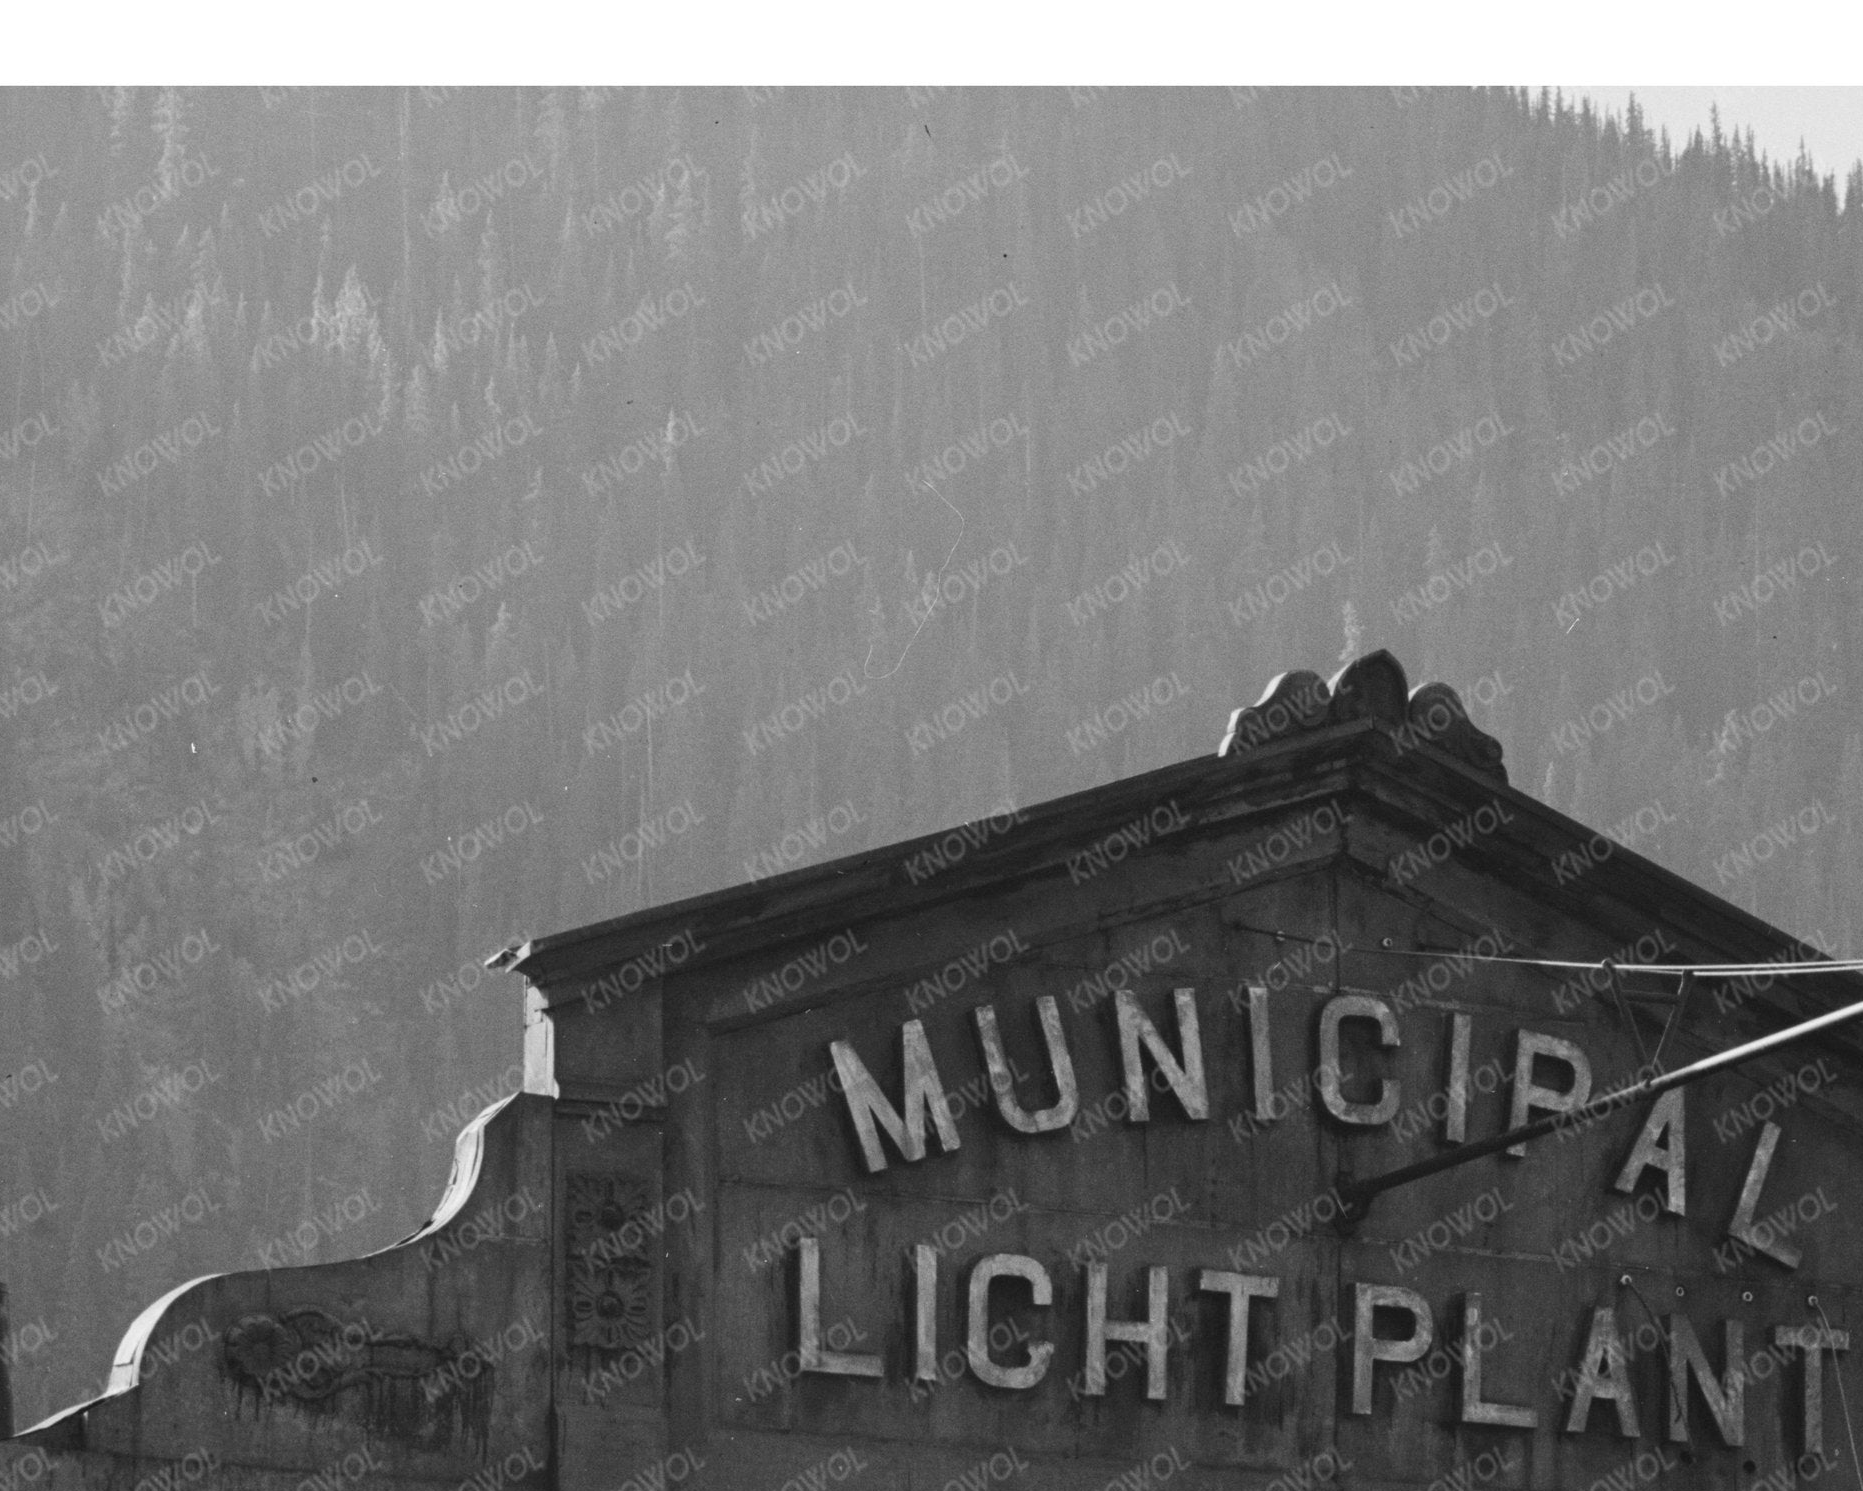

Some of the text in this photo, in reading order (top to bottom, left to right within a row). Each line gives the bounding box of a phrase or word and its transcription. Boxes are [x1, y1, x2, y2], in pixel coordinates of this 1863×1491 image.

[828, 986, 1804, 1271] MUNICIPAL
[799, 1237, 1850, 1454] LIGHT PLANT
